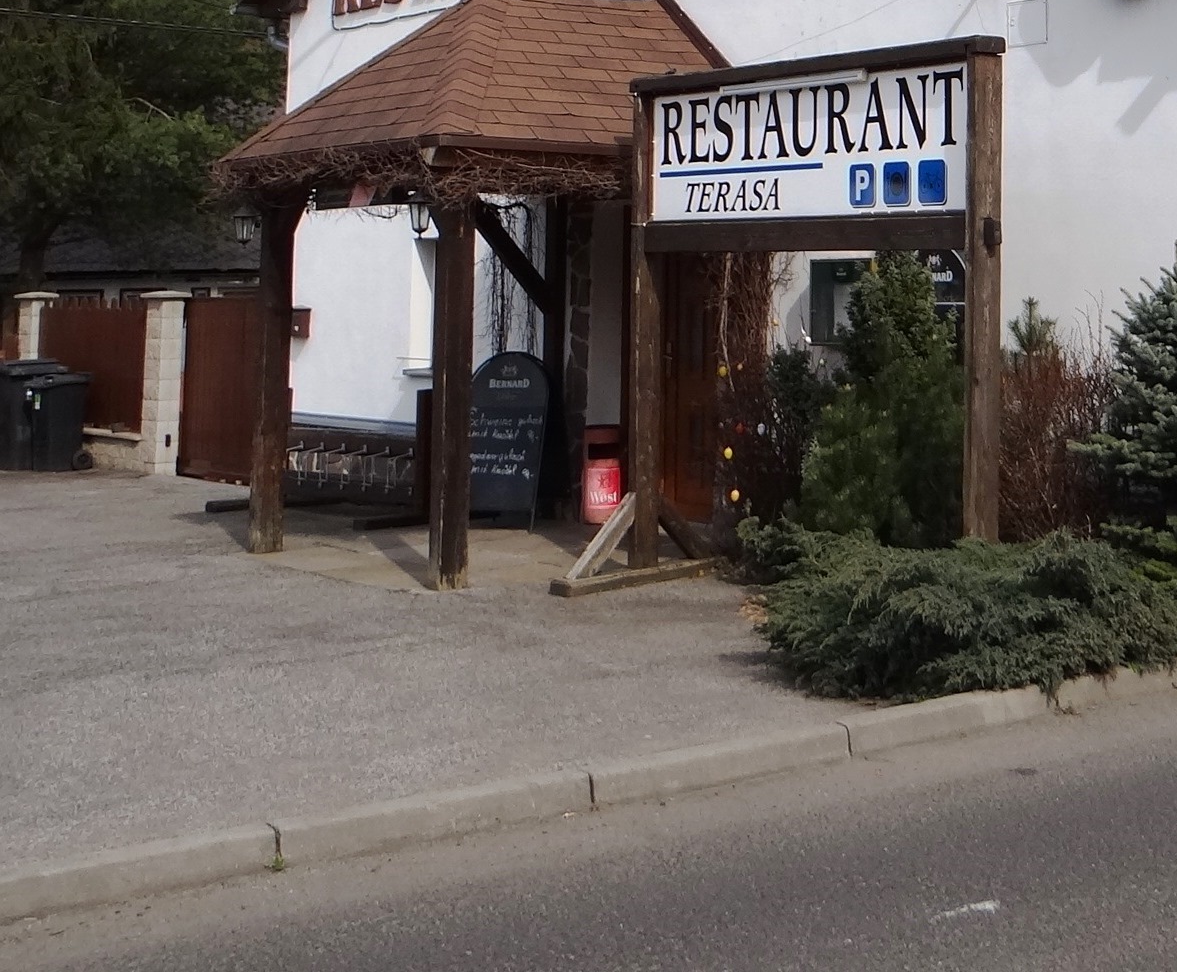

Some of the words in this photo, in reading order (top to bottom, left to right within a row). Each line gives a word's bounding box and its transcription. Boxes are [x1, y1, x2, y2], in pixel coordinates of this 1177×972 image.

[660, 66, 964, 167] RESTAURANT
[685, 178, 780, 213] TERASA
[855, 169, 870, 201] P
[931, 271, 954, 282] NARD
[488, 378, 530, 389] BERNARD
[589, 491, 618, 505] West
